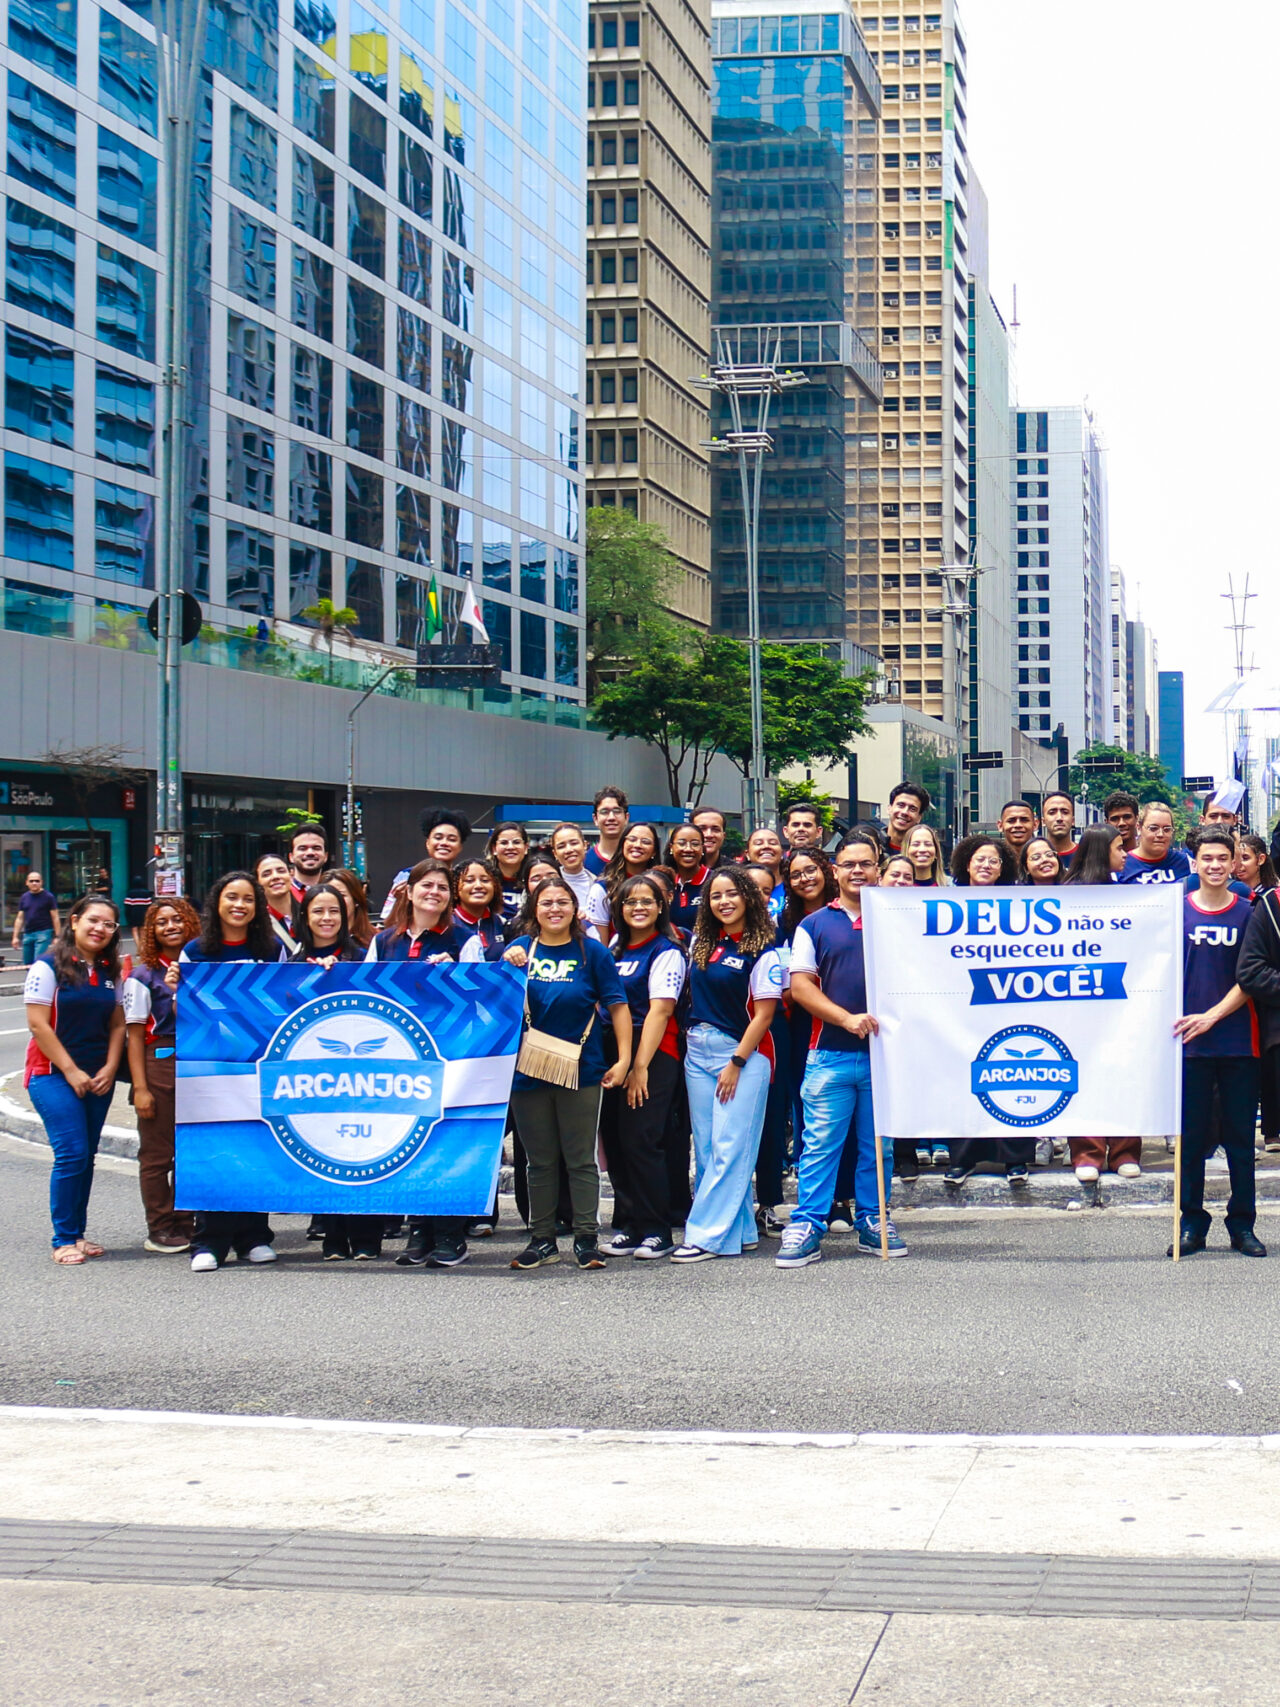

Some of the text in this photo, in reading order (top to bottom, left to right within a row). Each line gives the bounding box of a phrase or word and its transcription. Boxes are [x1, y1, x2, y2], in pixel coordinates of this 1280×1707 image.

[1136, 869, 1176, 885] FJU
[921, 897, 1132, 936] DEUS não se
[1188, 925, 1238, 947] FJU
[950, 939, 1102, 963] esqueceu de
[987, 965, 1105, 1000] VOCÊ!
[275, 999, 431, 1056] FORÇA JOVEM UNIVERSAL
[273, 1072, 432, 1100] ARCANJOS
[978, 1067, 1072, 1084] ARCANJOS
[1014, 1095, 1037, 1104] FJU
[336, 1124, 372, 1138] FJU
[277, 1124, 425, 1177] SEM LIMITES PARA RESGATAR
